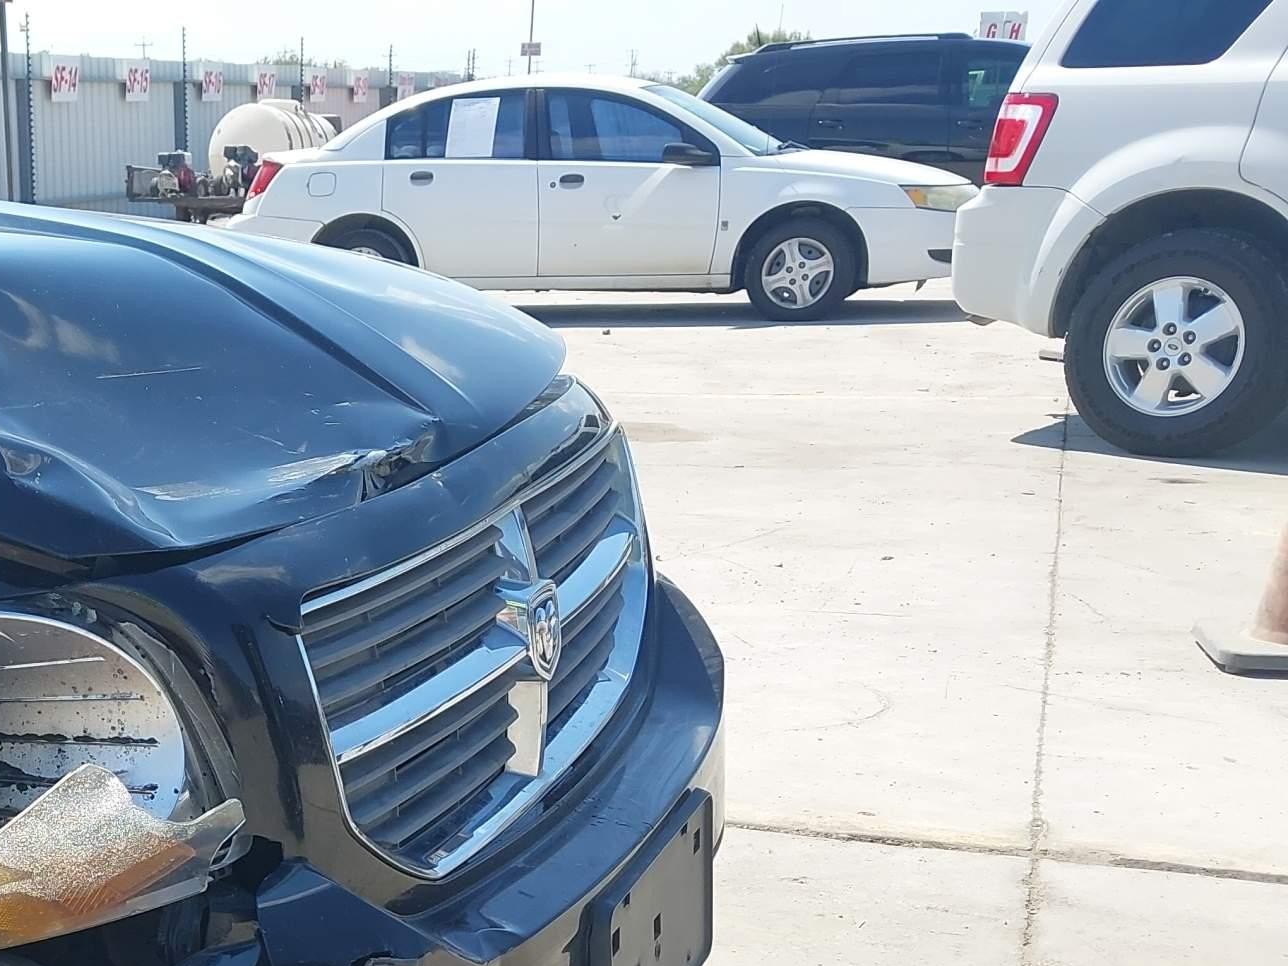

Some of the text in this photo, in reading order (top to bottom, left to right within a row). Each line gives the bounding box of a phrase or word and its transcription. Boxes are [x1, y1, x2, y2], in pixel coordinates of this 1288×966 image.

[986, 23, 998, 39] G
[1009, 22, 1022, 40] H
[53, 64, 79, 93] SF-14
[127, 67, 150, 95] SF-15
